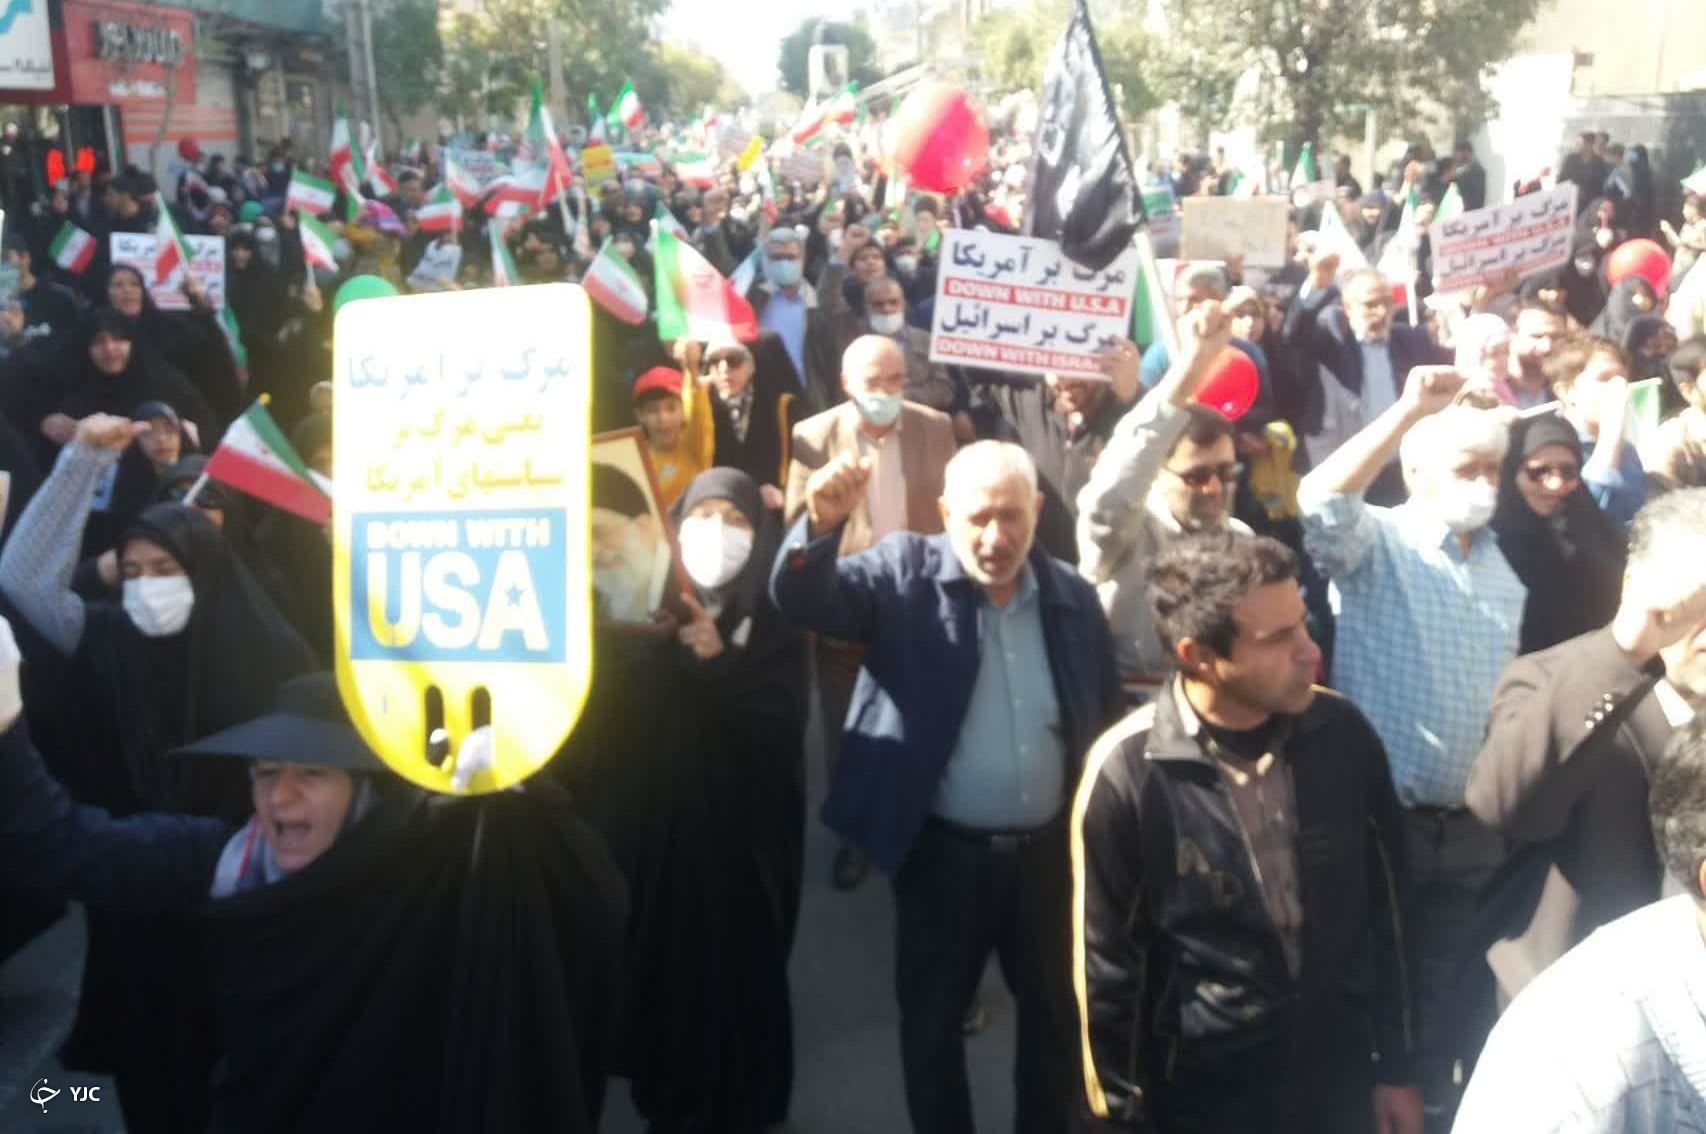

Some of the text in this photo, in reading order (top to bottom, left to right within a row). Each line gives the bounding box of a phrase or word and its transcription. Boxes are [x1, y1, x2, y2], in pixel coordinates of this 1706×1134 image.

[952, 242, 1035, 279] آمریکا
[1034, 260, 1061, 286] بر
[940, 303, 1031, 339] اسرائیل
[1034, 325, 1059, 346] بر
[367, 517, 550, 550] DOWN WITH
[367, 549, 550, 651] USA
